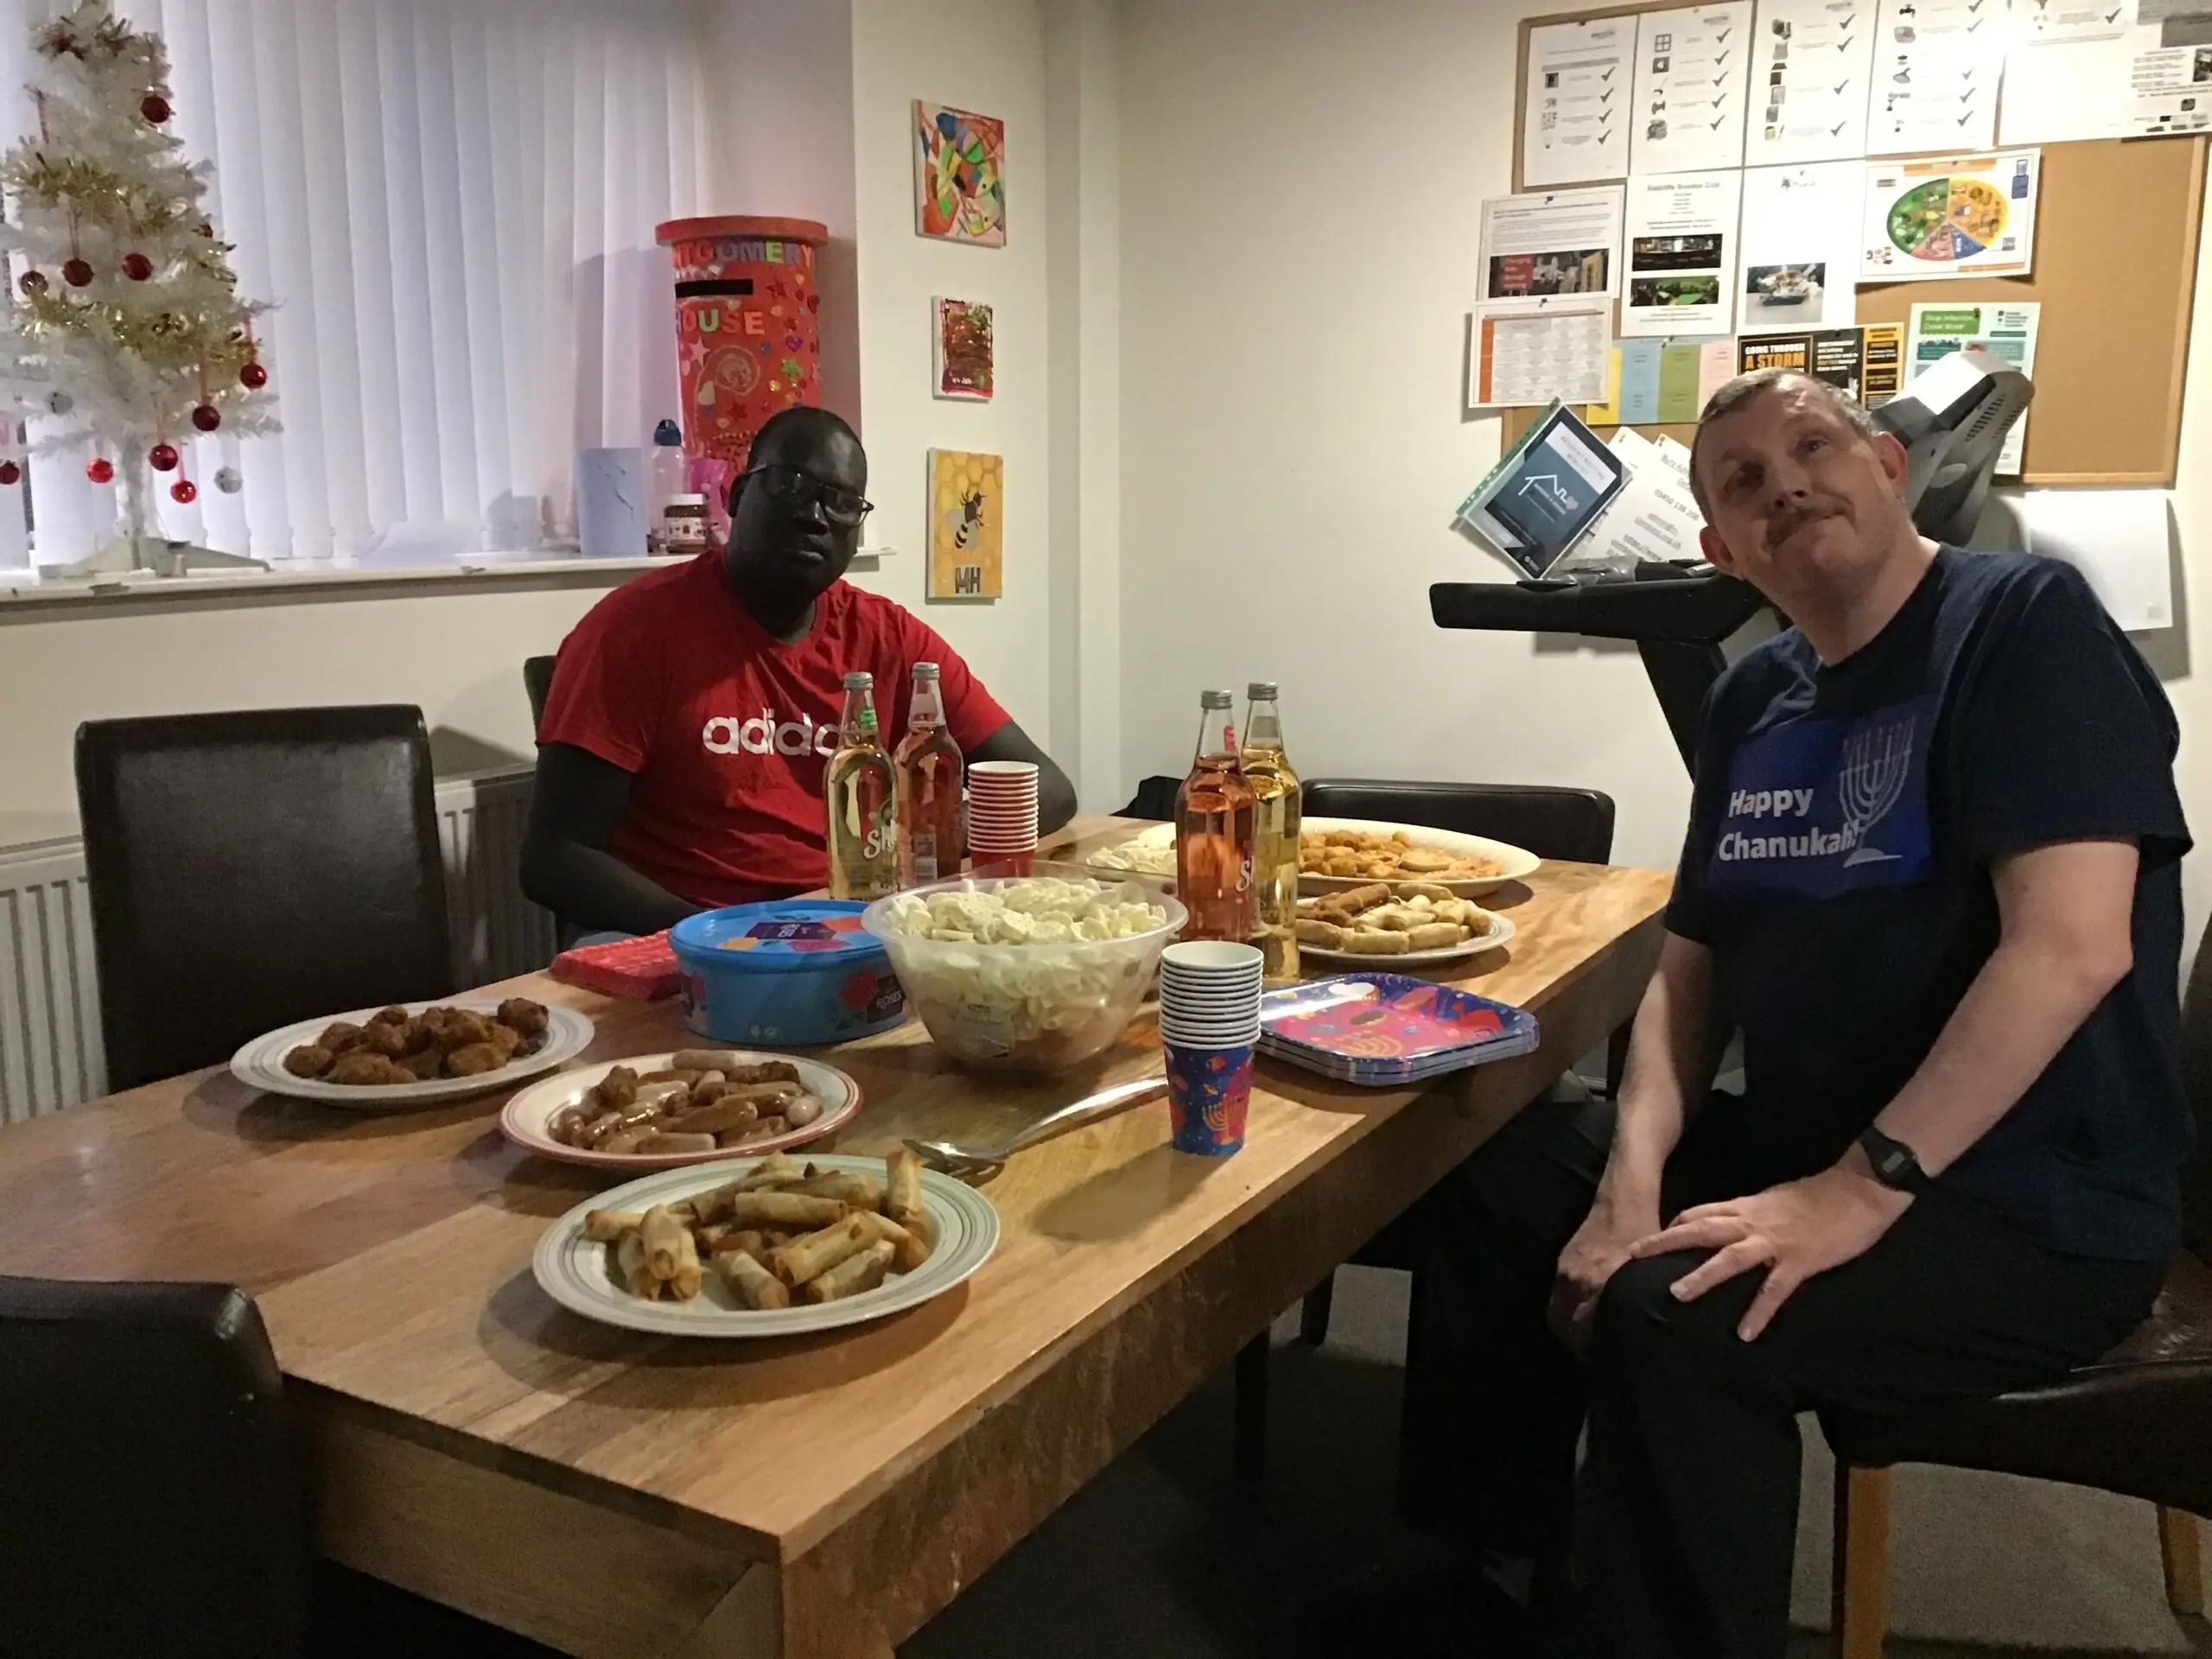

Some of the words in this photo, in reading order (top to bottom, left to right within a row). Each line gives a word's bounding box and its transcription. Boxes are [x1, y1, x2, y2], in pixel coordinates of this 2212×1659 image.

[1745, 345, 1769, 355] GOING
[1770, 342, 1806, 353] THROUGH
[1745, 354, 1755, 371] A
[1757, 352, 1806, 369] STORM
[955, 566, 982, 594] MH
[702, 707, 842, 757] adida
[1729, 788, 1814, 818] Happy
[1719, 818, 1859, 861] Chanukah!
